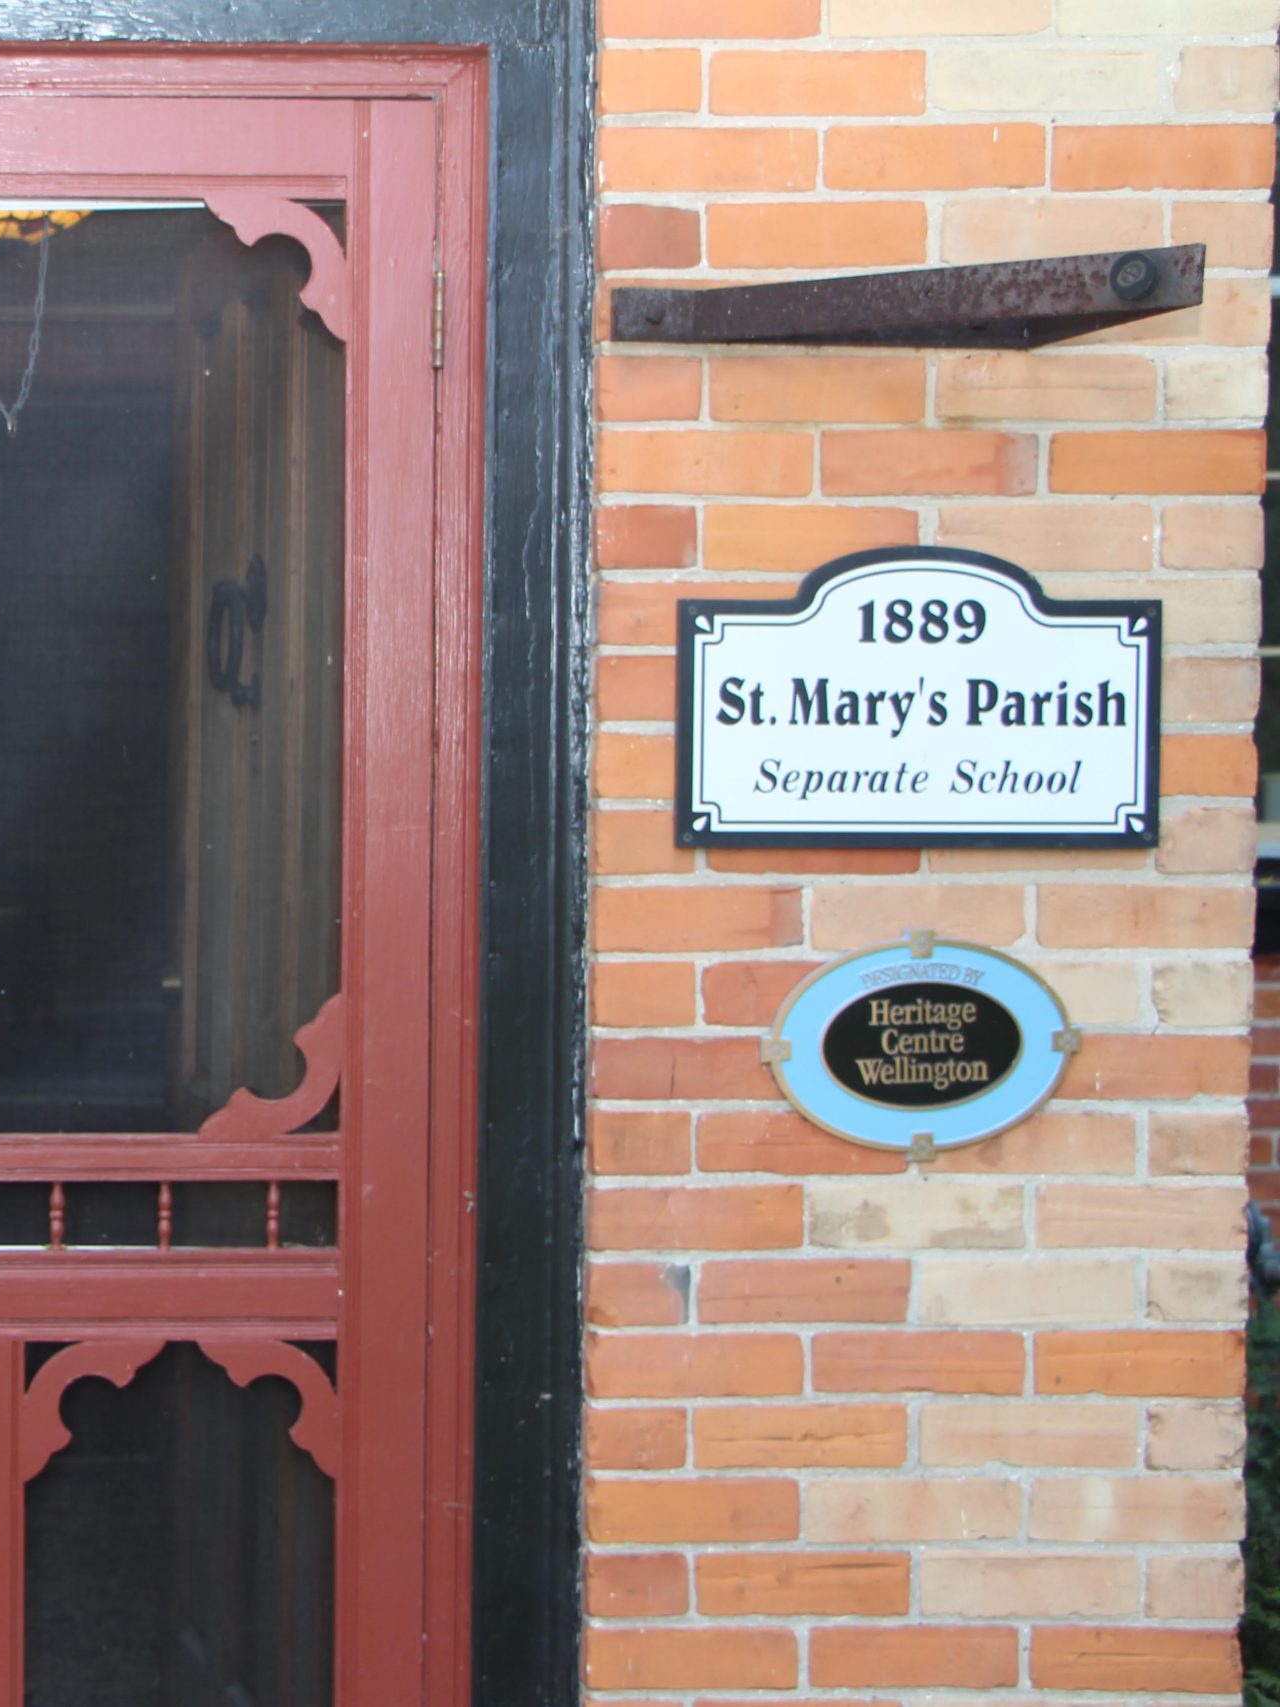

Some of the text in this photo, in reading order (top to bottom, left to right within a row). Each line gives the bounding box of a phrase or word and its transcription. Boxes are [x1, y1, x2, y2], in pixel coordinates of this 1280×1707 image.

[857, 599, 987, 644] 1889
[715, 676, 1127, 739] St. Mary's Parish
[753, 758, 1083, 800] Separate School
[859, 962, 986, 989] DESIGNATED BY
[868, 998, 977, 1031] Heritage
[880, 1028, 964, 1055] Centre
[855, 1056, 989, 1090] Wellington
